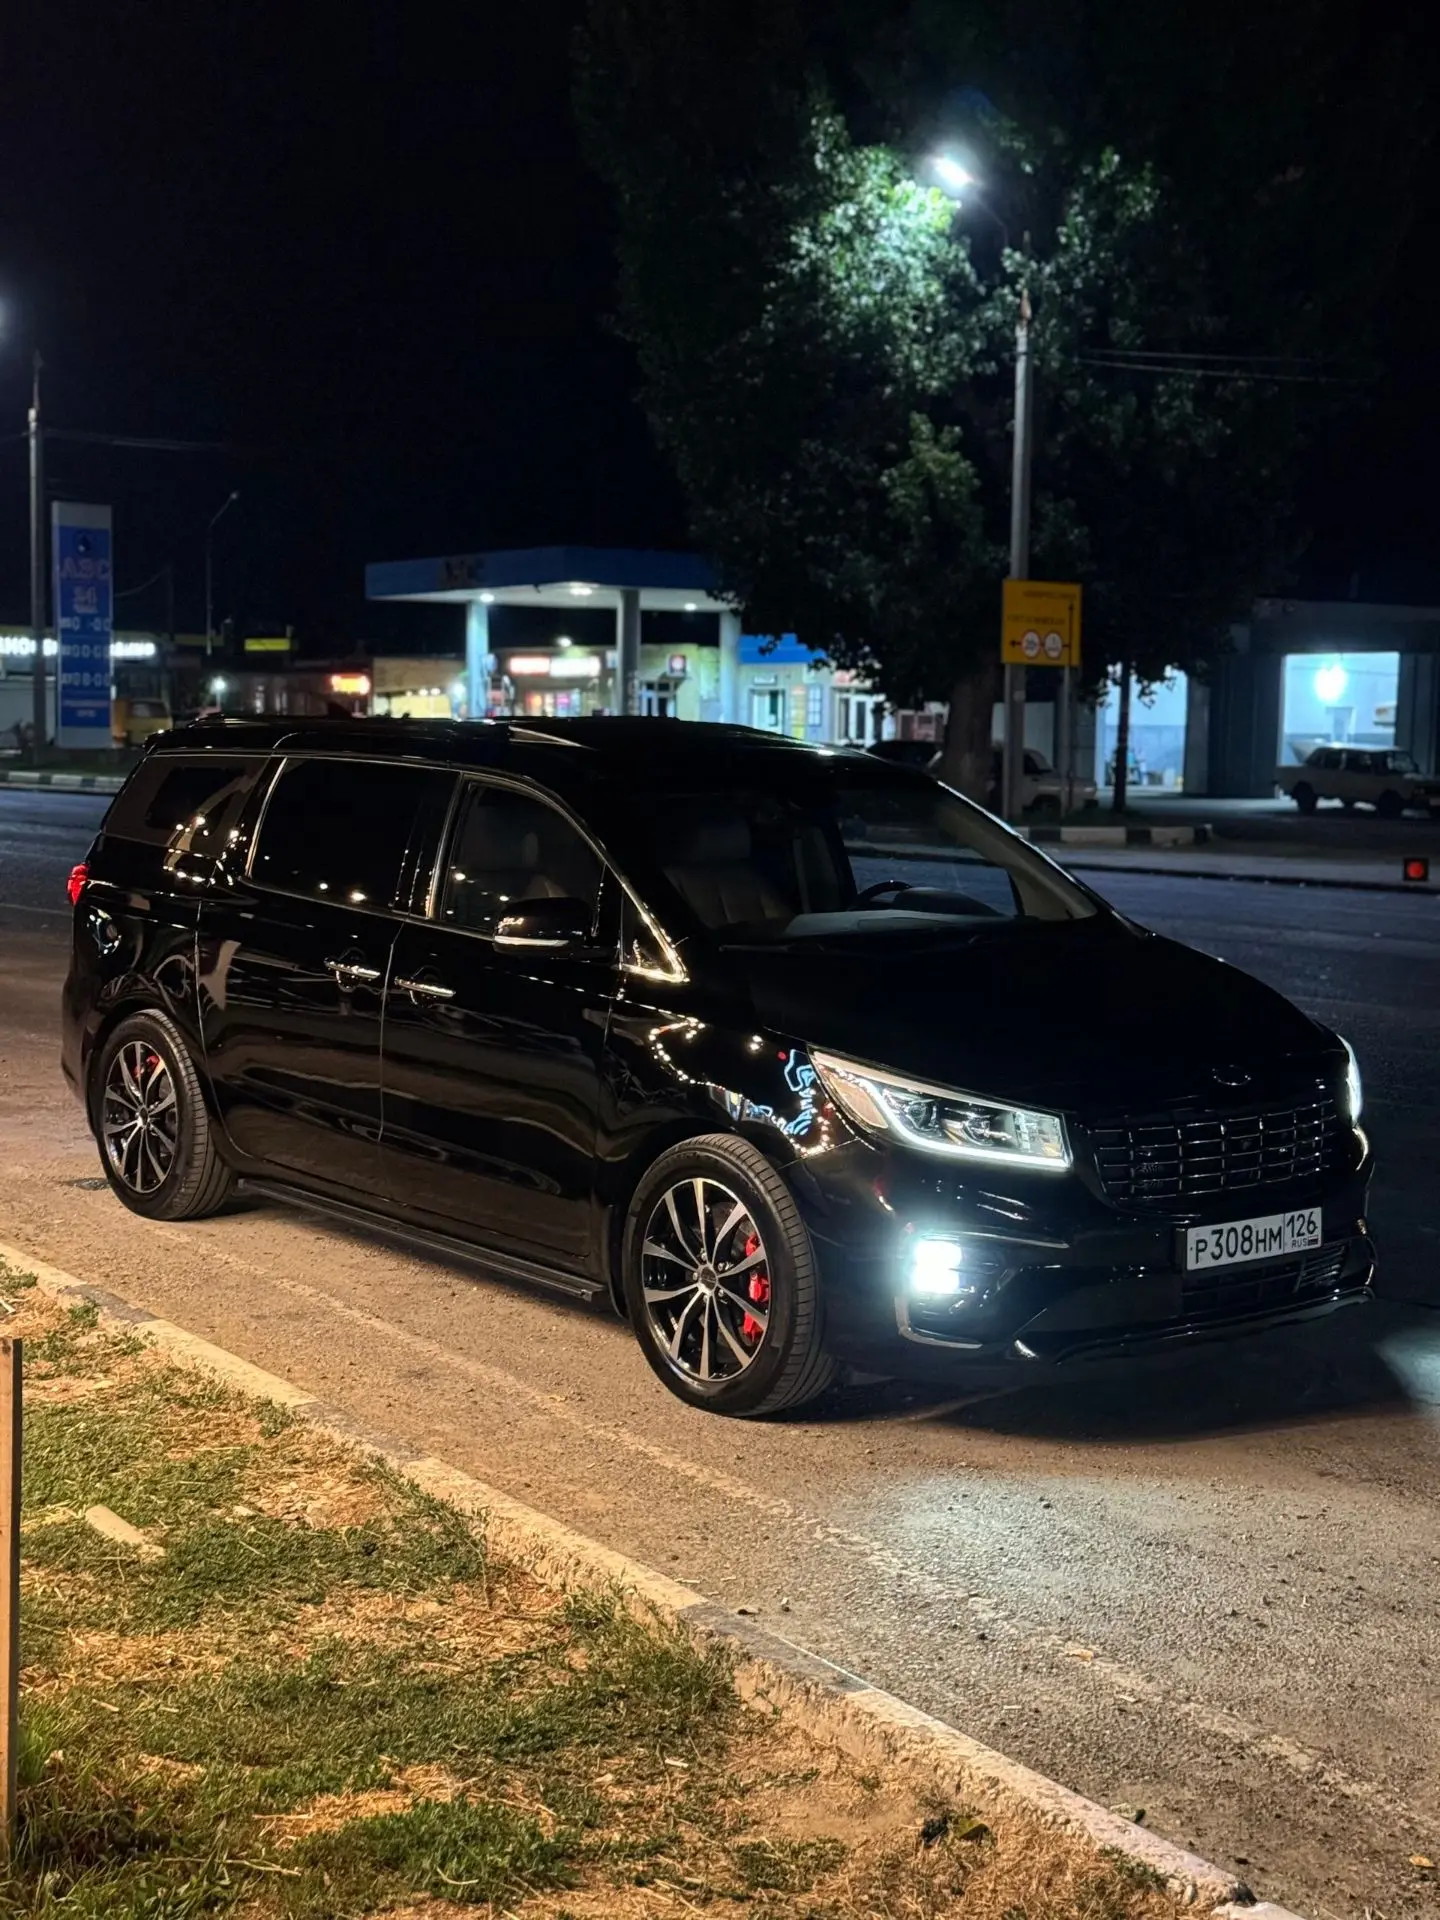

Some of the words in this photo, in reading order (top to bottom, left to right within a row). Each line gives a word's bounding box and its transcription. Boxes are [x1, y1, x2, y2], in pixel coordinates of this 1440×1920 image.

[1195, 1225, 1282, 1264] Р308НМ
[1286, 1211, 1318, 1238] 126
[1291, 1237, 1308, 1248] RUS
